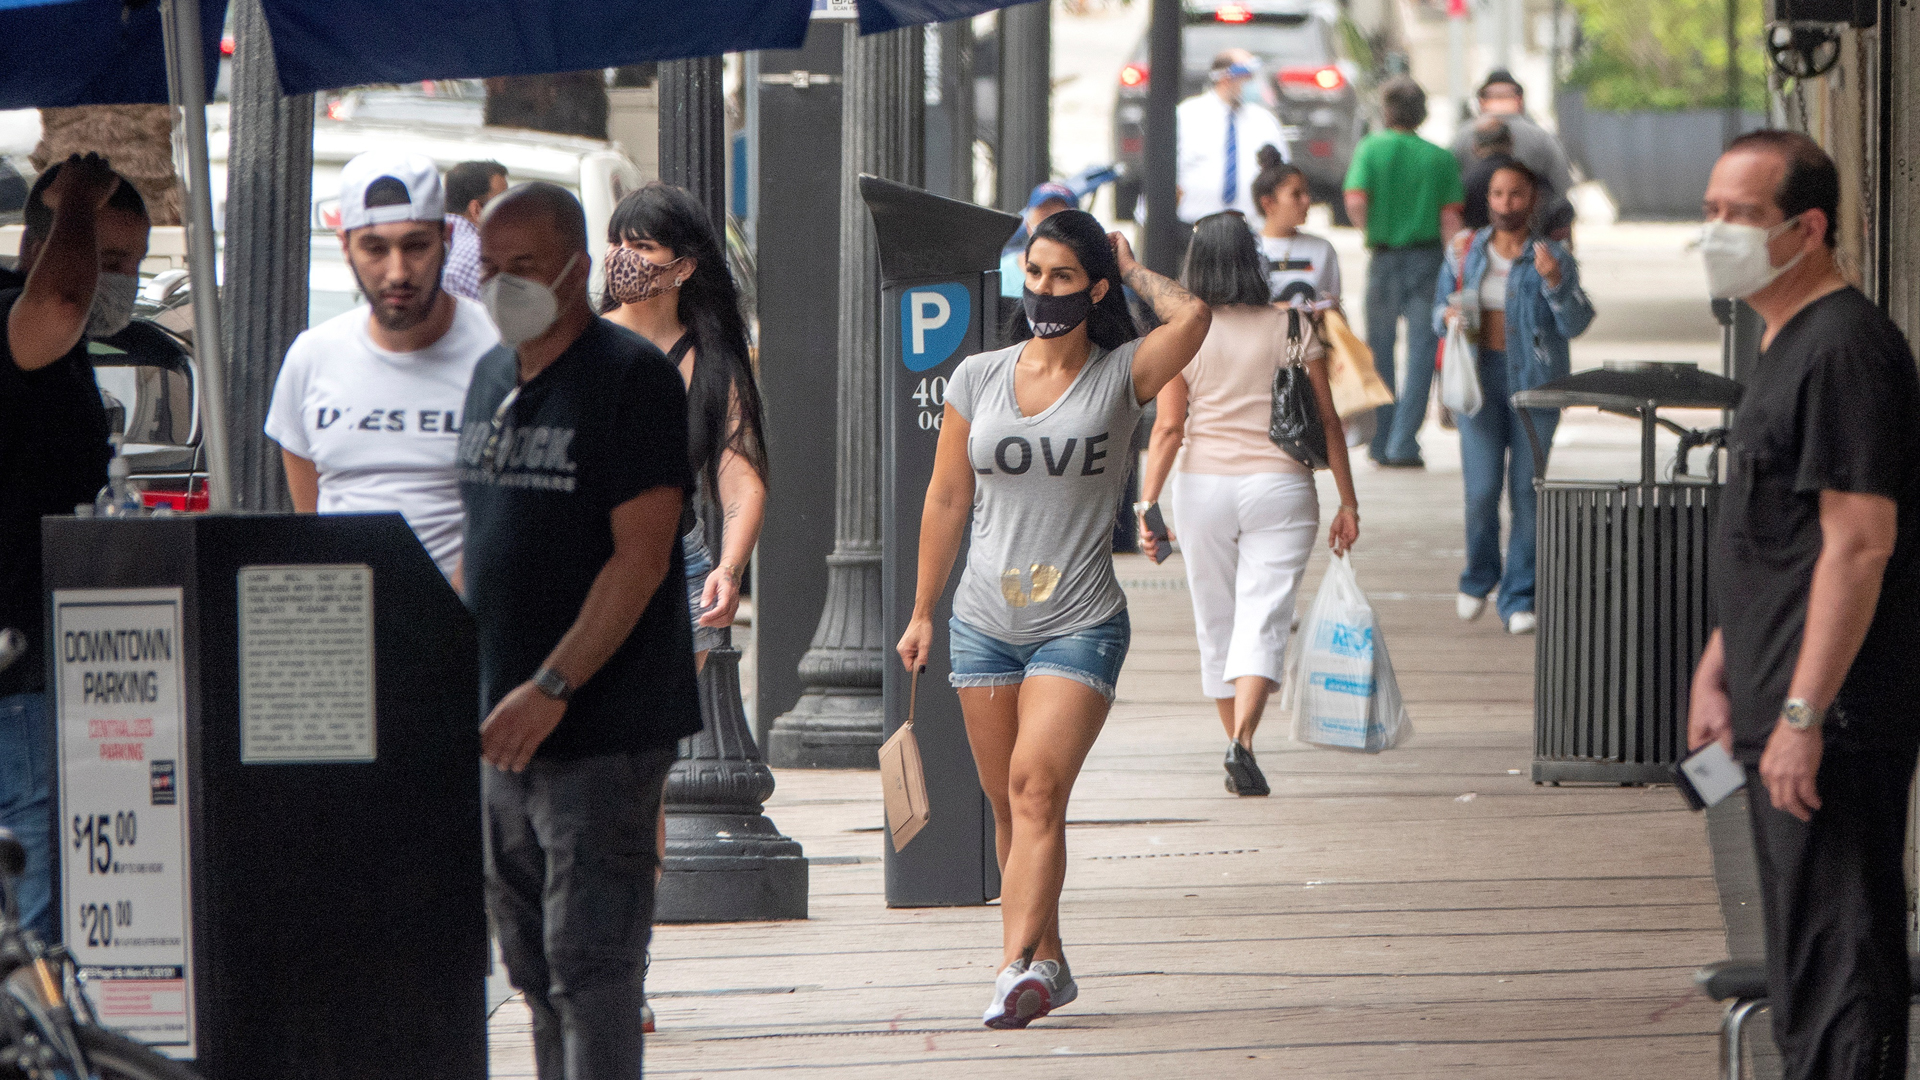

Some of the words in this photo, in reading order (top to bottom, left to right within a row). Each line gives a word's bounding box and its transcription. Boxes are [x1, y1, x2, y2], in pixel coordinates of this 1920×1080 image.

[911, 291, 951, 354] P
[970, 432, 1109, 476] LOVE
[64, 628, 171, 662] DOWNTOWN
[83, 670, 158, 704] PARKING
